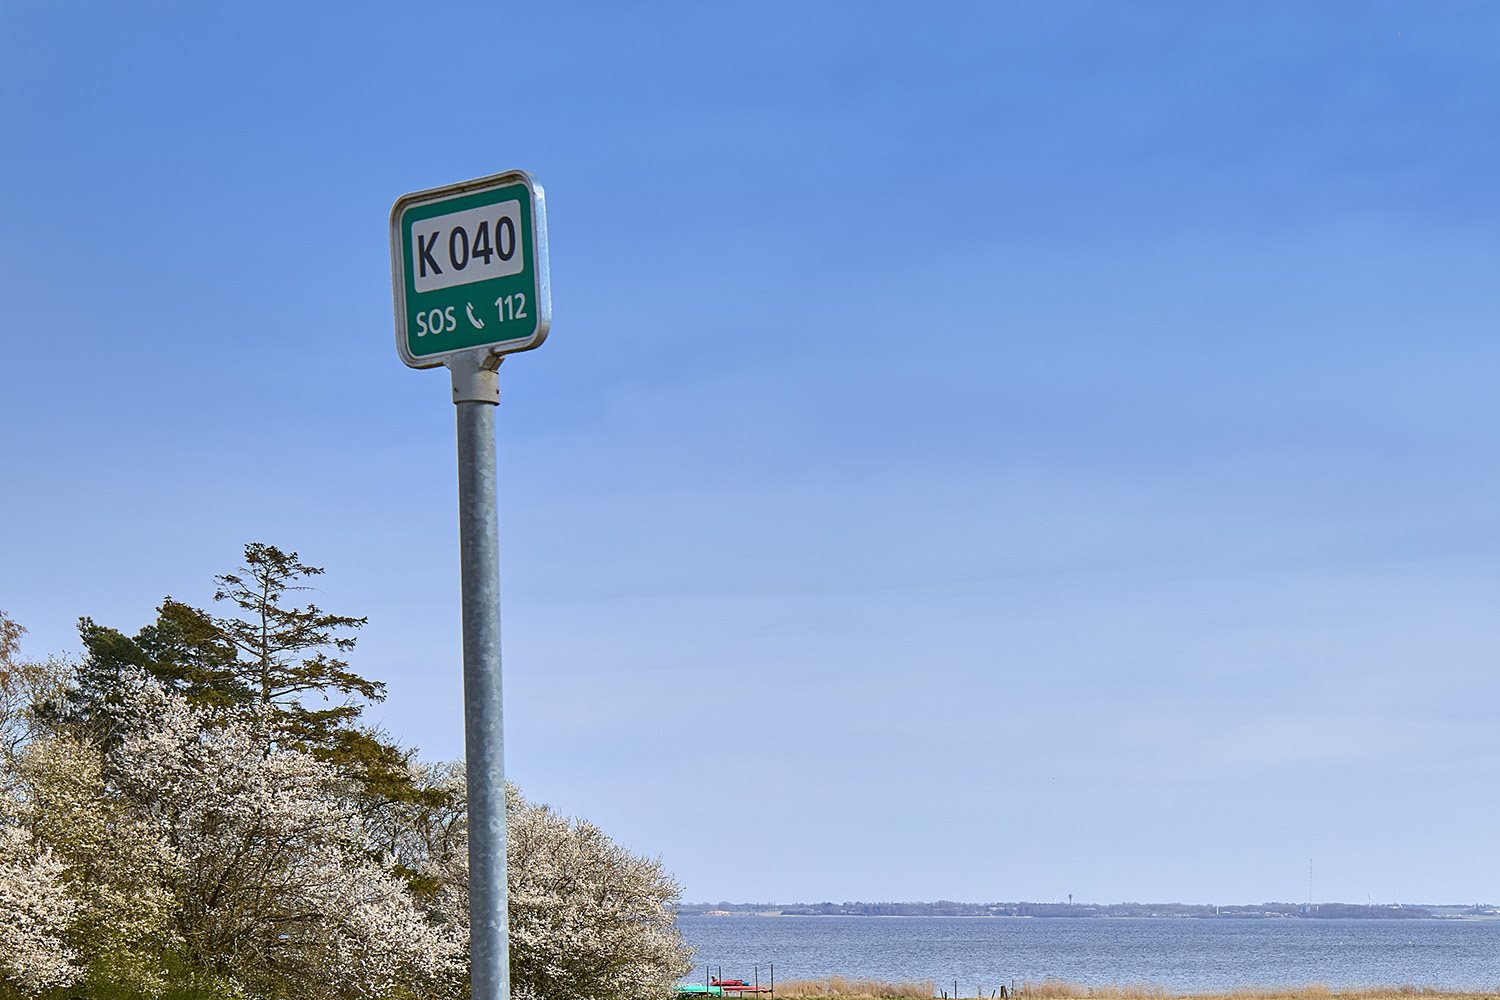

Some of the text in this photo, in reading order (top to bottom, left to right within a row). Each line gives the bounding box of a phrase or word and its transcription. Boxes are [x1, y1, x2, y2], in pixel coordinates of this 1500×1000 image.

[417, 216, 516, 278] K 040
[416, 293, 527, 337] SOS 112
